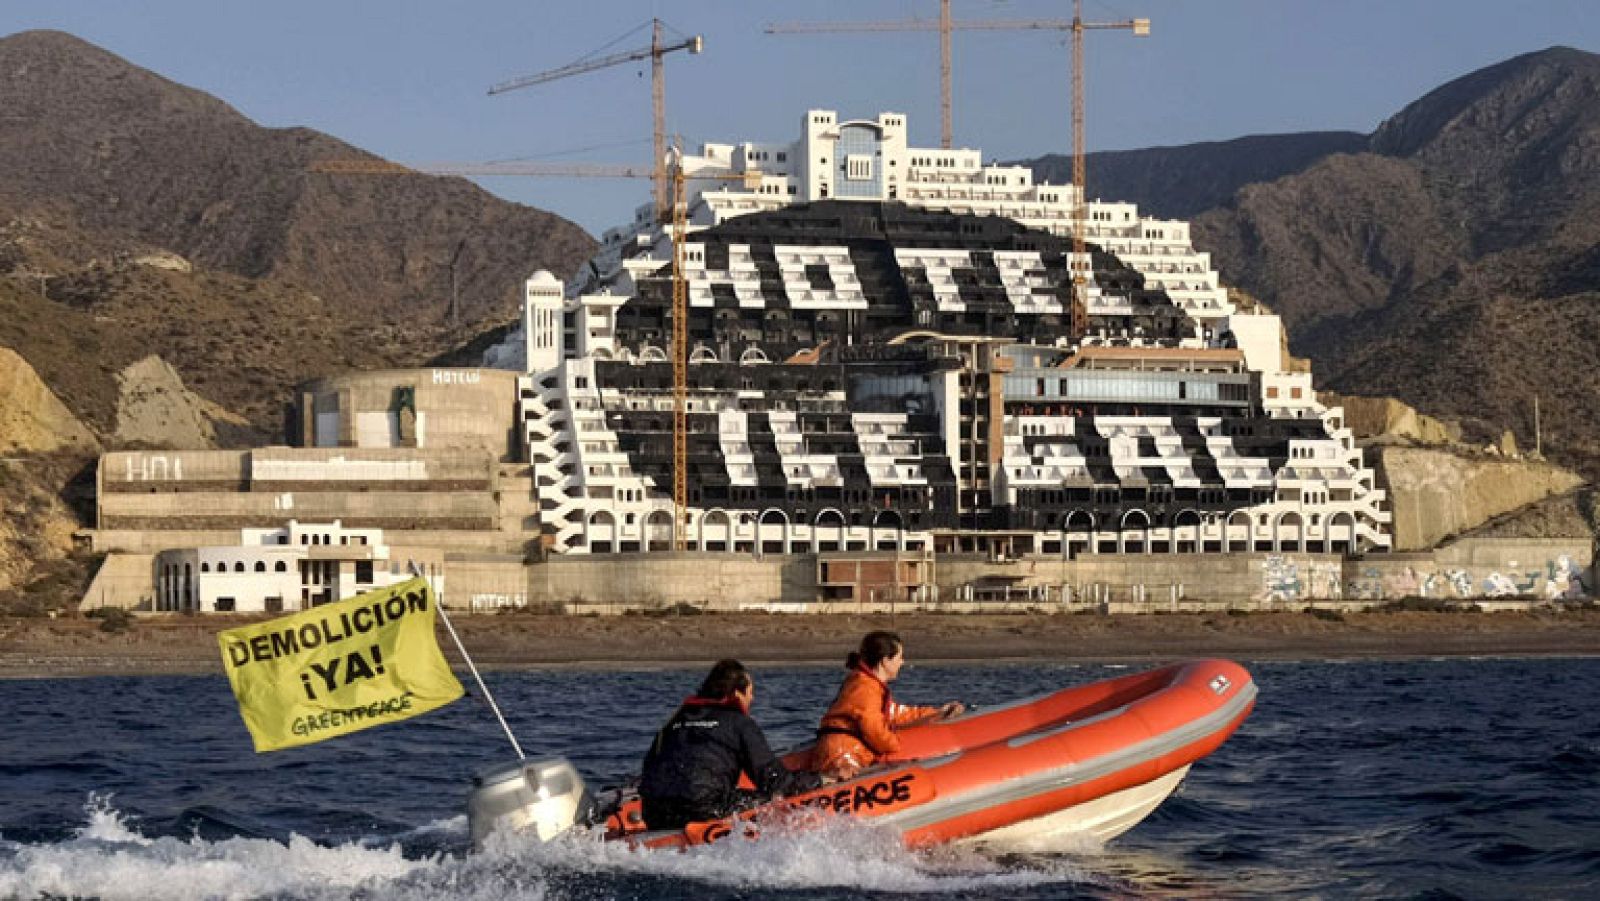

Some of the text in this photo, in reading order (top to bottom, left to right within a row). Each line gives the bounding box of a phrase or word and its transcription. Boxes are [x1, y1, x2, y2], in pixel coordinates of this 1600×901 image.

[678, 243, 1133, 315] HOTEL
[228, 587, 428, 668] DEMOLICIÓN
[301, 645, 385, 700] ¡YA!
[291, 691, 413, 736] GREENPEACE
